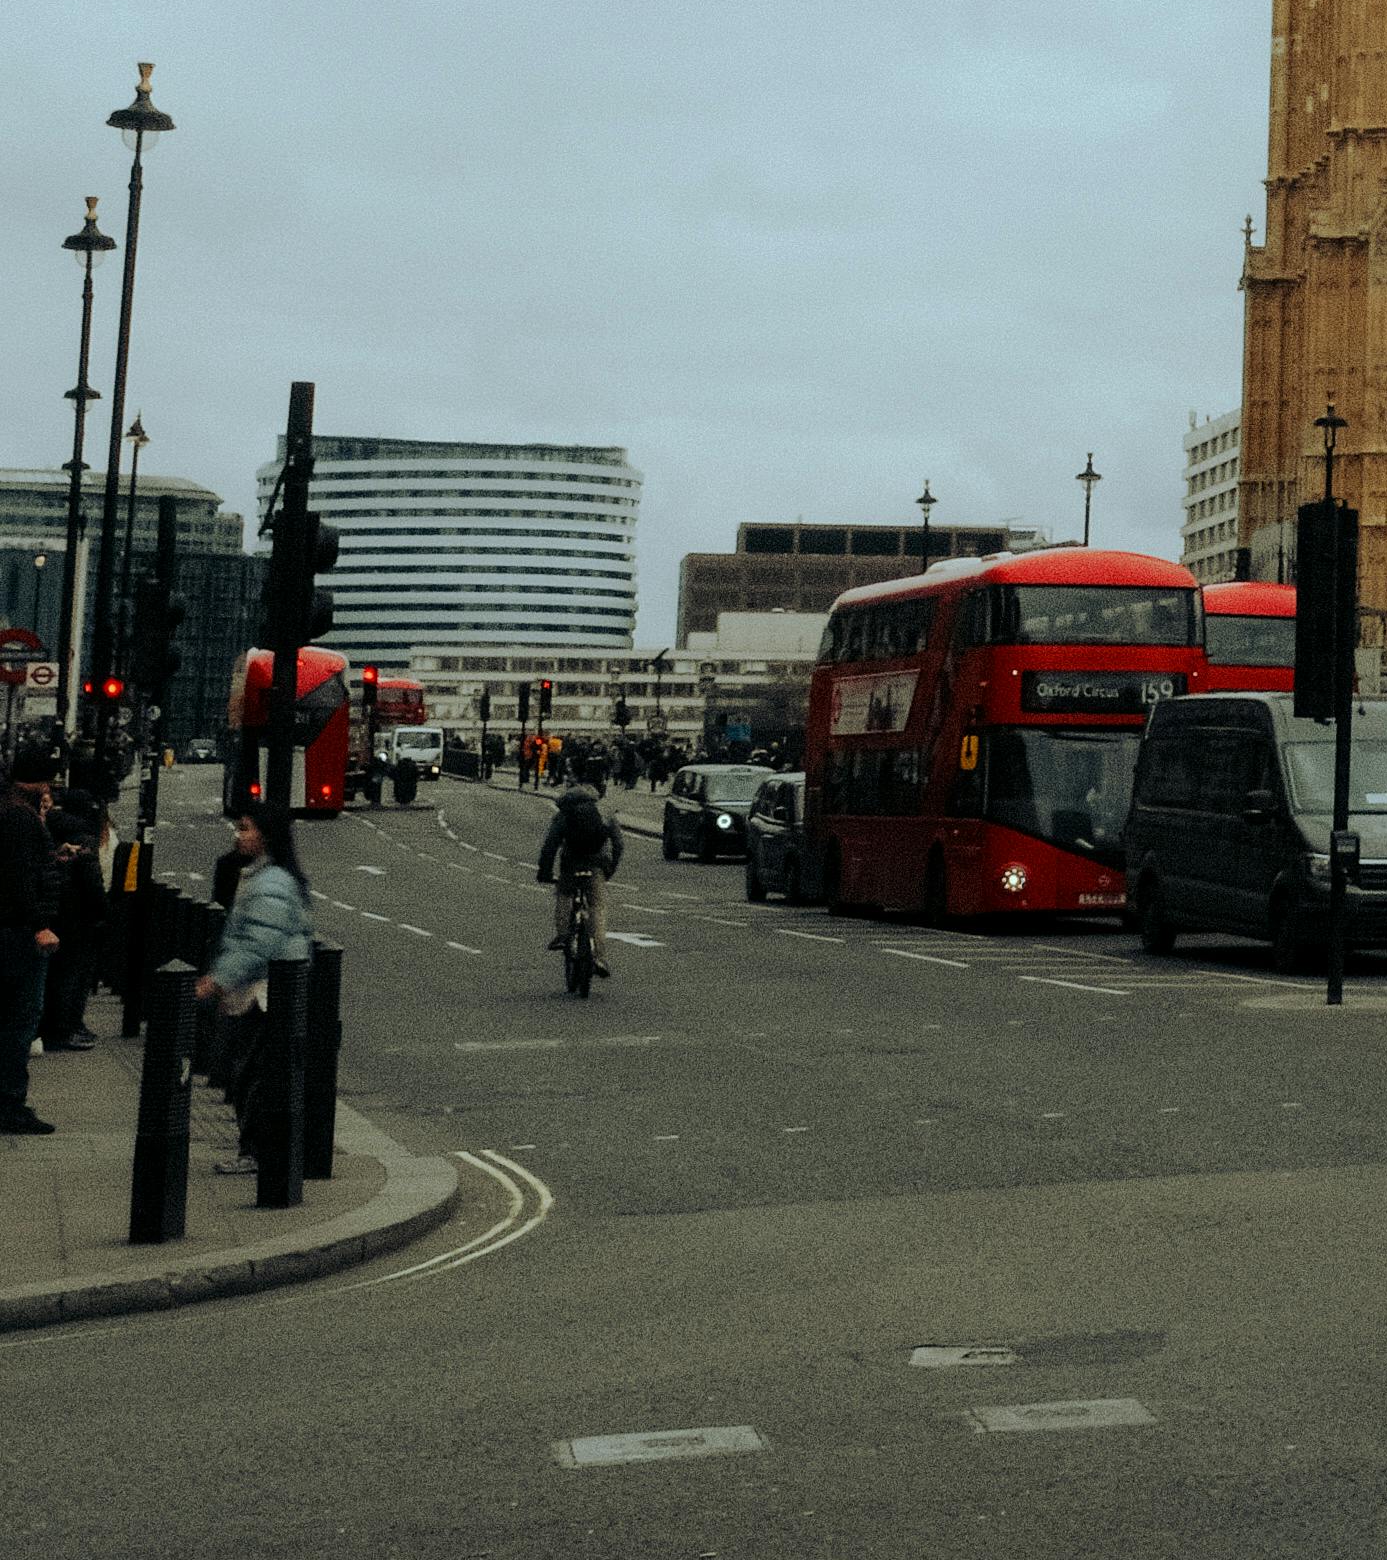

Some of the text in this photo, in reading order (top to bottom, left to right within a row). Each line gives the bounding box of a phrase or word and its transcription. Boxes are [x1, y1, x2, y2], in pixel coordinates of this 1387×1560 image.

[1036, 680, 1174, 705] Oxford Circus 159
